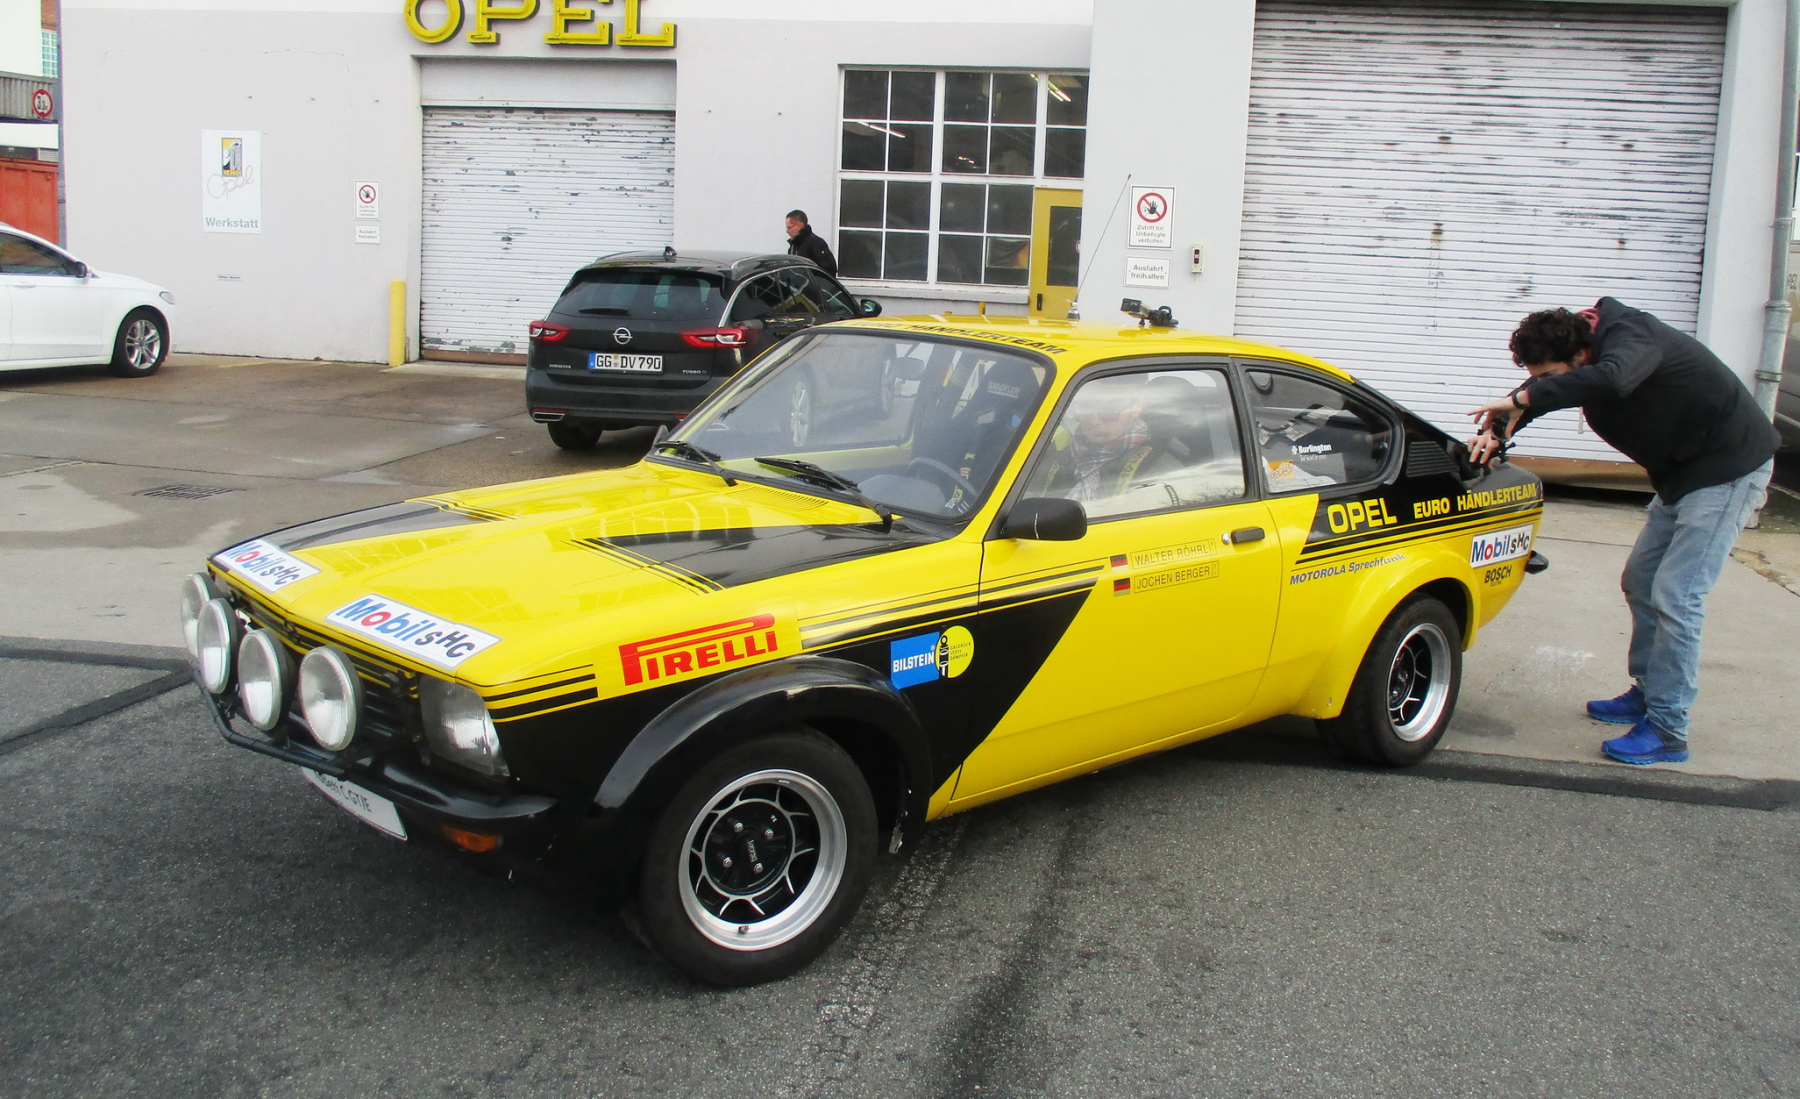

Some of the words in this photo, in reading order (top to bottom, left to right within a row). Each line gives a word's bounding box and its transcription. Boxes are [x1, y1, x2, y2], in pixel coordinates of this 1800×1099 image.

[403, 0, 677, 48] OPEL
[205, 217, 259, 229] Werkstatt
[1130, 272, 1164, 280] freihalten
[1133, 264, 1163, 272] Ausfahrt
[596, 355, 612, 368] GG
[620, 356, 635, 369] DV
[638, 358, 661, 370] 790
[1298, 443, 1332, 454] Burlington
[1327, 499, 1397, 534] OPEL
[1413, 498, 1450, 519] EURO
[1457, 482, 1538, 512] HÄNDLERTEAM
[1134, 550, 1177, 566] WALTER
[1177, 544, 1209, 556] RÖHRL
[1136, 575, 1173, 589] JOCHEN
[1175, 566, 1210, 581] BERGER
[1290, 565, 1346, 585] MOTOROLA
[1348, 554, 1406, 573] Sprechfunk
[1484, 565, 1513, 584] BOSCH
[334, 598, 436, 641] Mobil
[618, 613, 778, 686] PIRELLI
[892, 651, 935, 673] BILSTEIN
